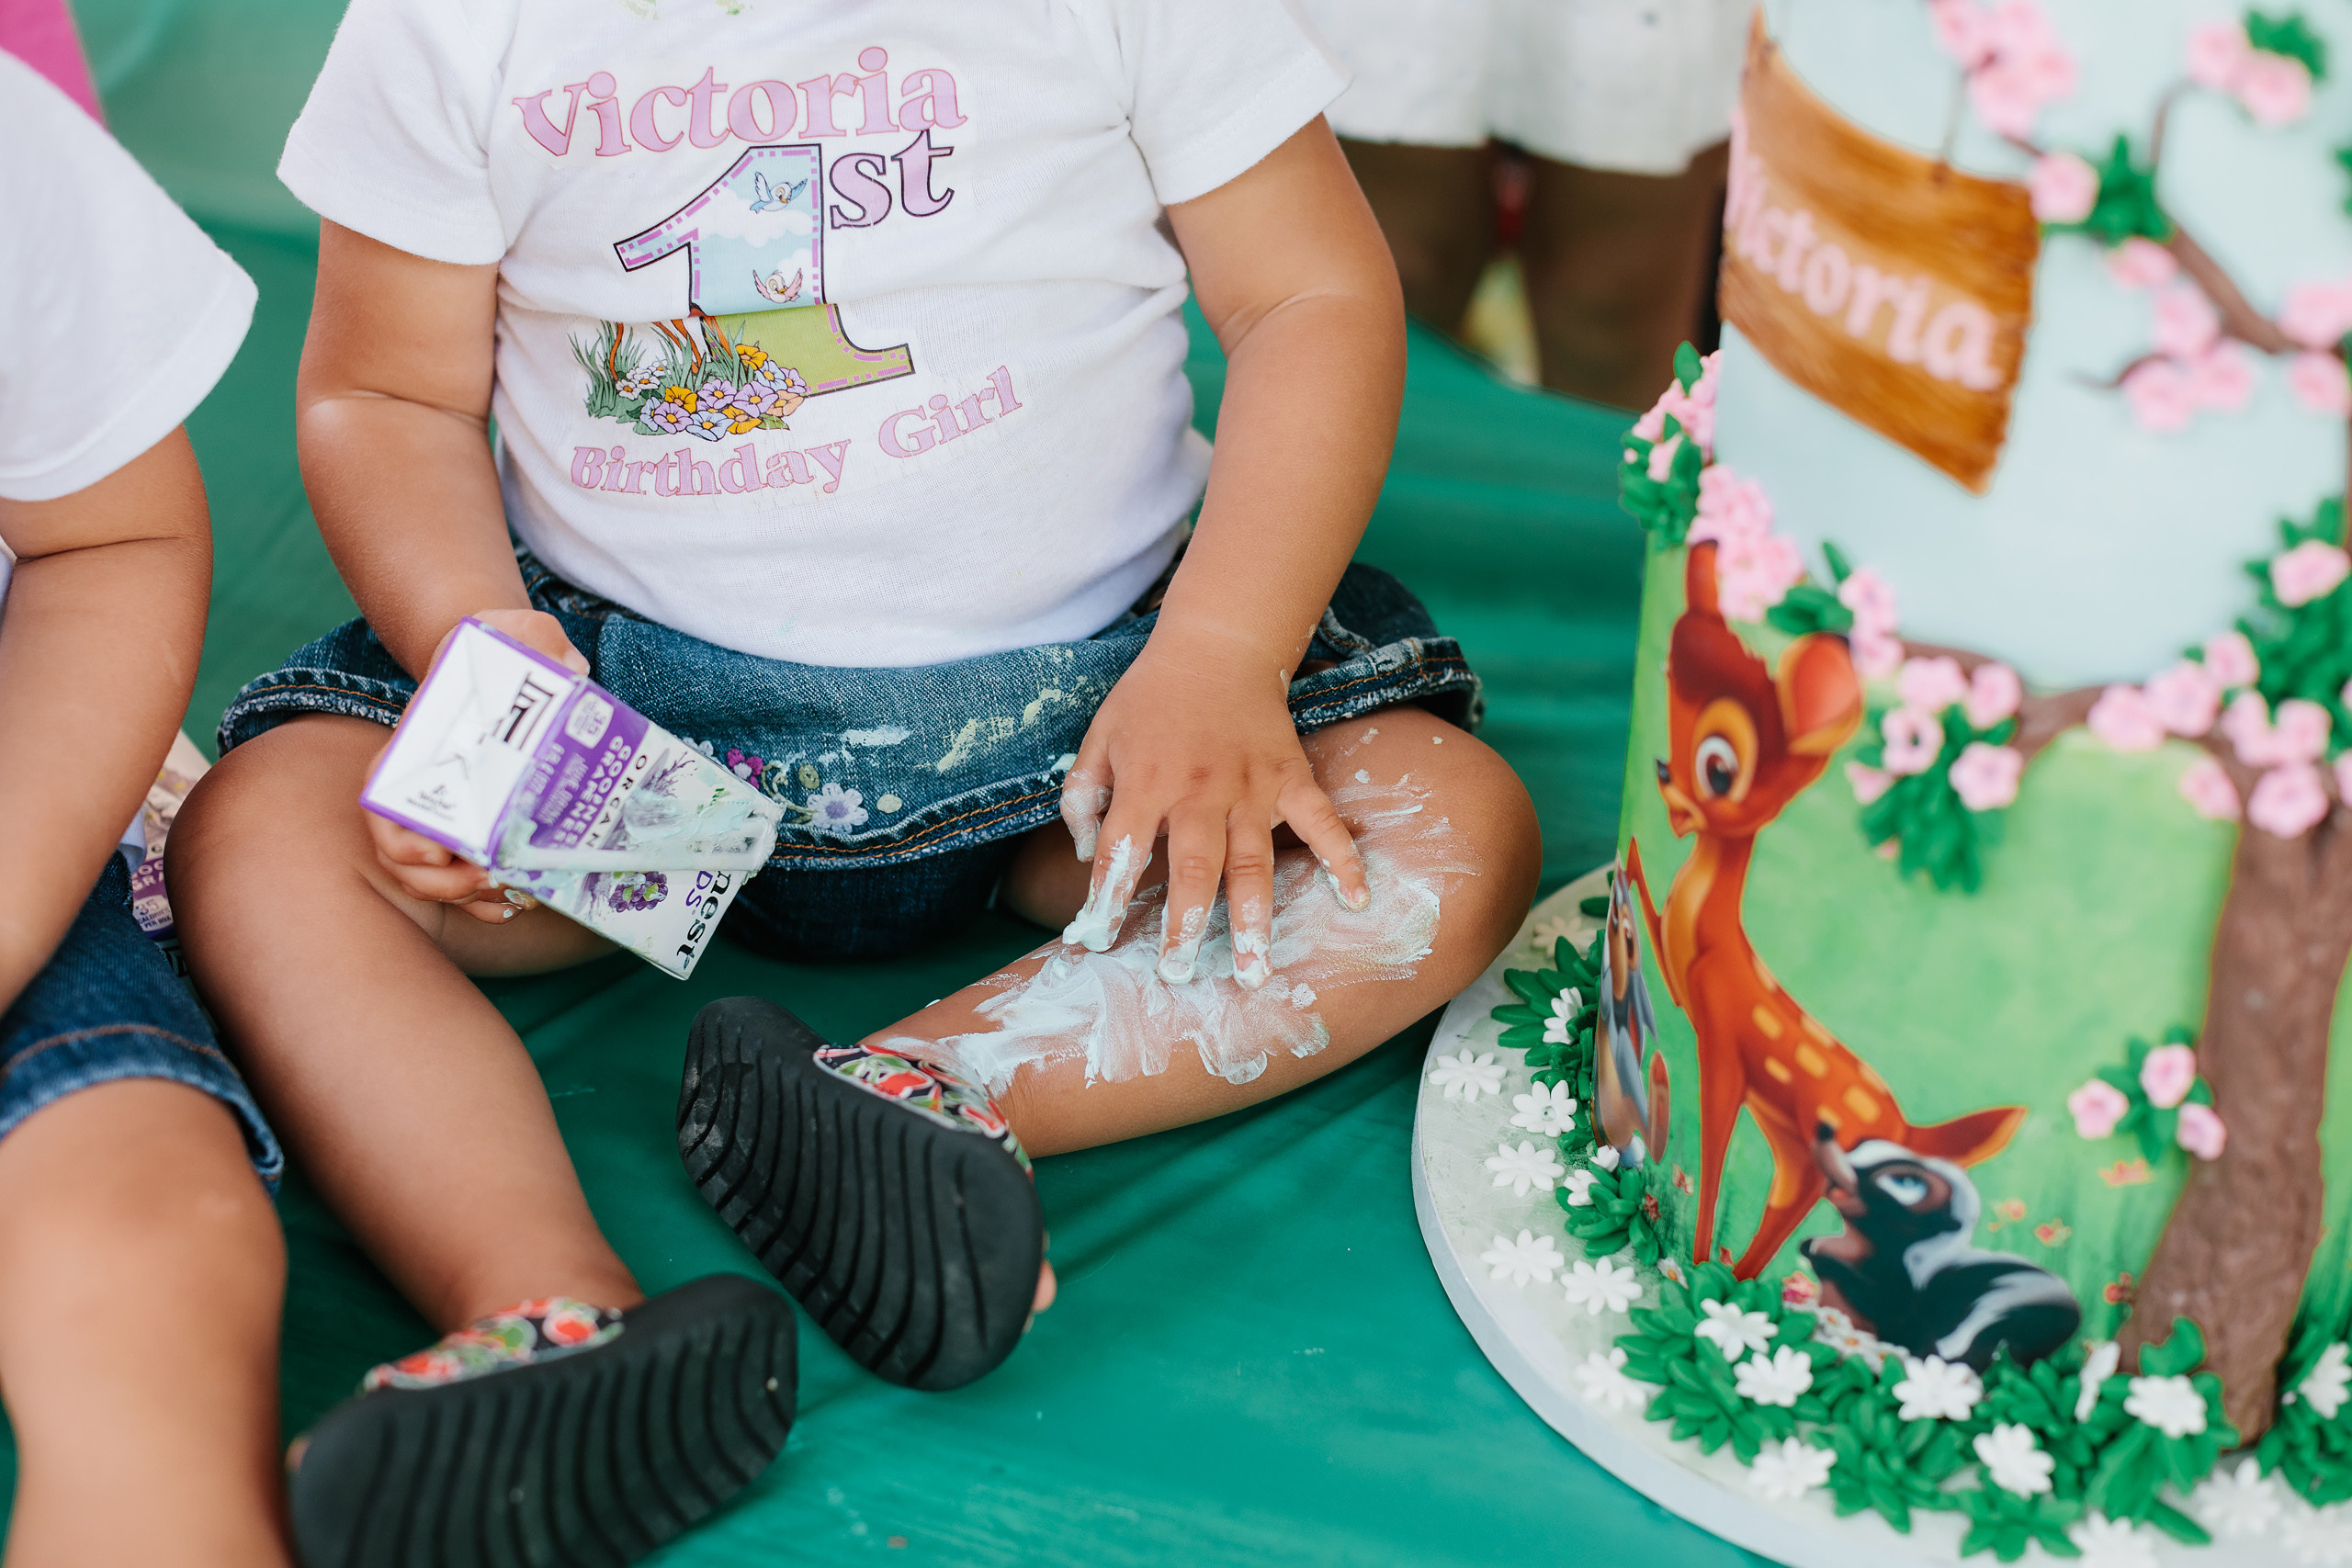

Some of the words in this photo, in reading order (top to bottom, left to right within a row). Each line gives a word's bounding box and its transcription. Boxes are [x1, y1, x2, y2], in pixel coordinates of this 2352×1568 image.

[512, 46, 968, 157] Victoria
[571, 438, 852, 497] Birthday
[877, 365, 1023, 459] Girl
[553, 736, 624, 843] GRAPENES
[564, 745, 633, 845] GOODNES
[585, 755, 648, 848] ORGAN
[135, 898, 160, 916] 35
[676, 870, 732, 971] nest
[685, 870, 714, 908] DS
